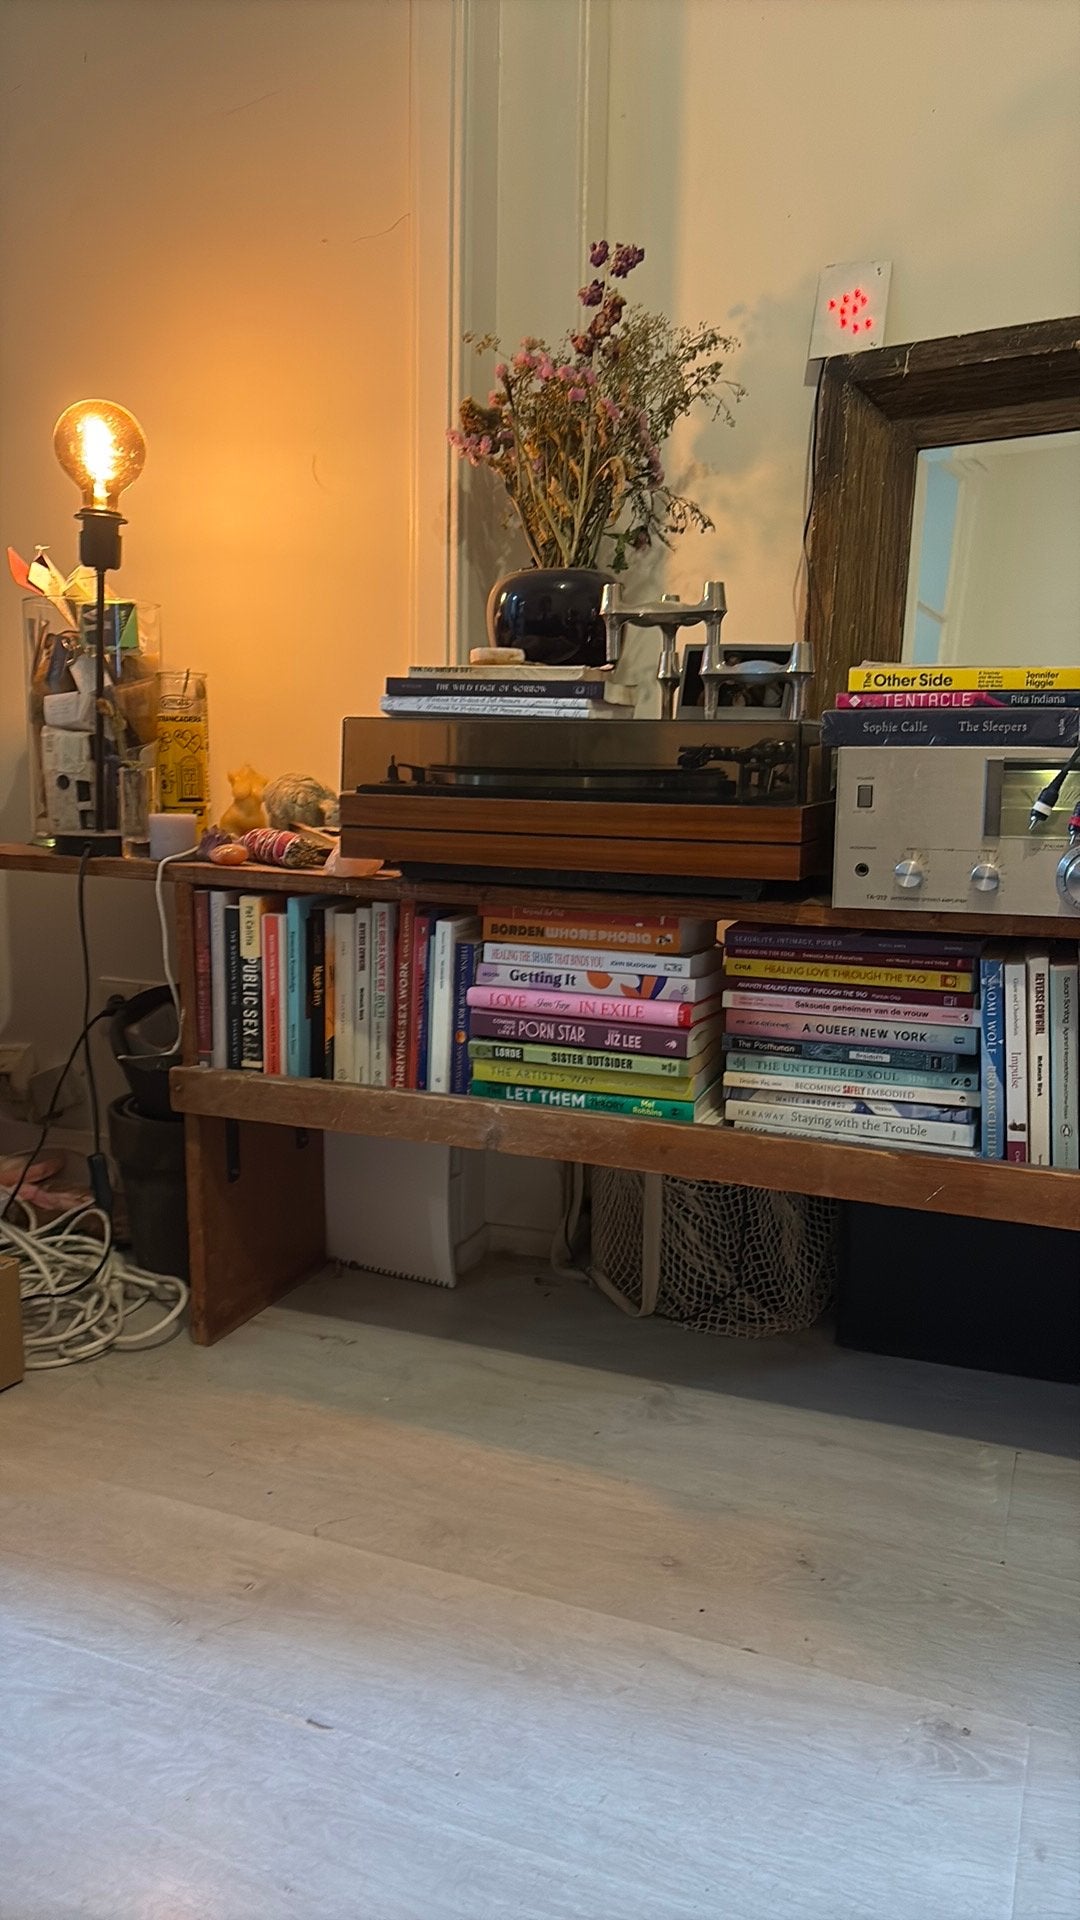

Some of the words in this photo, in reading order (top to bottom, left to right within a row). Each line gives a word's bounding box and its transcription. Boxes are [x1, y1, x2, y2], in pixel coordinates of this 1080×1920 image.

[863, 672, 871, 688] The
[874, 673, 916, 687] Other
[919, 673, 953, 687] Side
[1026, 671, 1059, 680] Jennifer
[1026, 680, 1054, 688] Higgie
[436, 683, 449, 691] THE
[452, 684, 473, 692] WILD
[475, 684, 496, 692] EDGE
[512, 685, 547, 693] SORROW
[883, 693, 972, 707] TENTACLE
[1011, 695, 1029, 704] Rita
[1031, 695, 1066, 704] Indiana
[862, 721, 898, 734] Sophie
[901, 721, 928, 732] Calle
[959, 721, 979, 732] The
[982, 721, 1028, 734] Sleepers
[245, 906, 253, 917] Pat
[491, 924, 544, 937] BORDEN
[816, 939, 843, 947] POWER
[242, 958, 259, 1005] PUBLIC
[398, 963, 409, 1000] WORK
[510, 969, 562, 988] Getting
[564, 974, 577, 986] It
[764, 964, 804, 975] HEALING
[806, 966, 830, 977] LOVE
[833, 968, 881, 981] THROUGH
[884, 972, 903, 983] THE
[906, 974, 926, 984] TAO
[763, 984, 787, 992] HEALING
[813, 987, 841, 996] THROUGH
[843, 989, 854, 997] THE
[986, 975, 997, 1017] NAOMI
[1035, 973, 1045, 1005] REVERSE
[489, 992, 527, 1008] LOVE
[579, 1000, 597, 1014] IN
[601, 1002, 645, 1018] EXILE
[397, 1003, 408, 1026] SEX
[795, 1001, 831, 1011] Seksuele
[832, 1004, 872, 1014] geheimen
[903, 1010, 929, 1018] vrouw
[1062, 999, 1070, 1024] Sontag
[242, 1008, 259, 1036] SEX
[1035, 1006, 1045, 1036] COWGIRL
[518, 1020, 555, 1040] PORN
[557, 1024, 586, 1043] STAR
[604, 1030, 621, 1046] JIZ
[622, 1035, 642, 1049] LEE
[802, 1023, 811, 1033] A
[815, 1024, 856, 1037] QUEER
[860, 1028, 889, 1039] NEW
[893, 1030, 928, 1042] YORK
[986, 1021, 997, 1055] WOLF
[495, 1047, 522, 1059] LORDE
[738, 1040, 751, 1048] The
[753, 1041, 795, 1052] Posthuman
[395, 1031, 406, 1088] THRIVING
[551, 1052, 583, 1066] SISTER
[586, 1055, 633, 1070] OUTSIDER
[490, 1065, 512, 1077] THE
[571, 1074, 595, 1086] WAY
[755, 1060, 780, 1071] THE
[783, 1063, 863, 1079] UNTETHERED
[866, 1069, 900, 1081] SOUL
[1009, 1052, 1022, 1089] Impulse
[505, 1086, 534, 1102] LET
[538, 1089, 586, 1108] THEM
[795, 1081, 841, 1093] BECOMING
[842, 1085, 865, 1095] SAFELY
[867, 1087, 915, 1099] EMBODIED
[632, 1106, 663, 1117] Robbins
[640, 1099, 656, 1108] Mel
[986, 1065, 997, 1159] PROMISCUITIES
[737, 1109, 784, 1120] HARAWAY
[791, 1111, 832, 1128] Staying
[834, 1117, 858, 1129] with
[862, 1119, 880, 1132] the
[882, 1121, 927, 1137] Trouble
